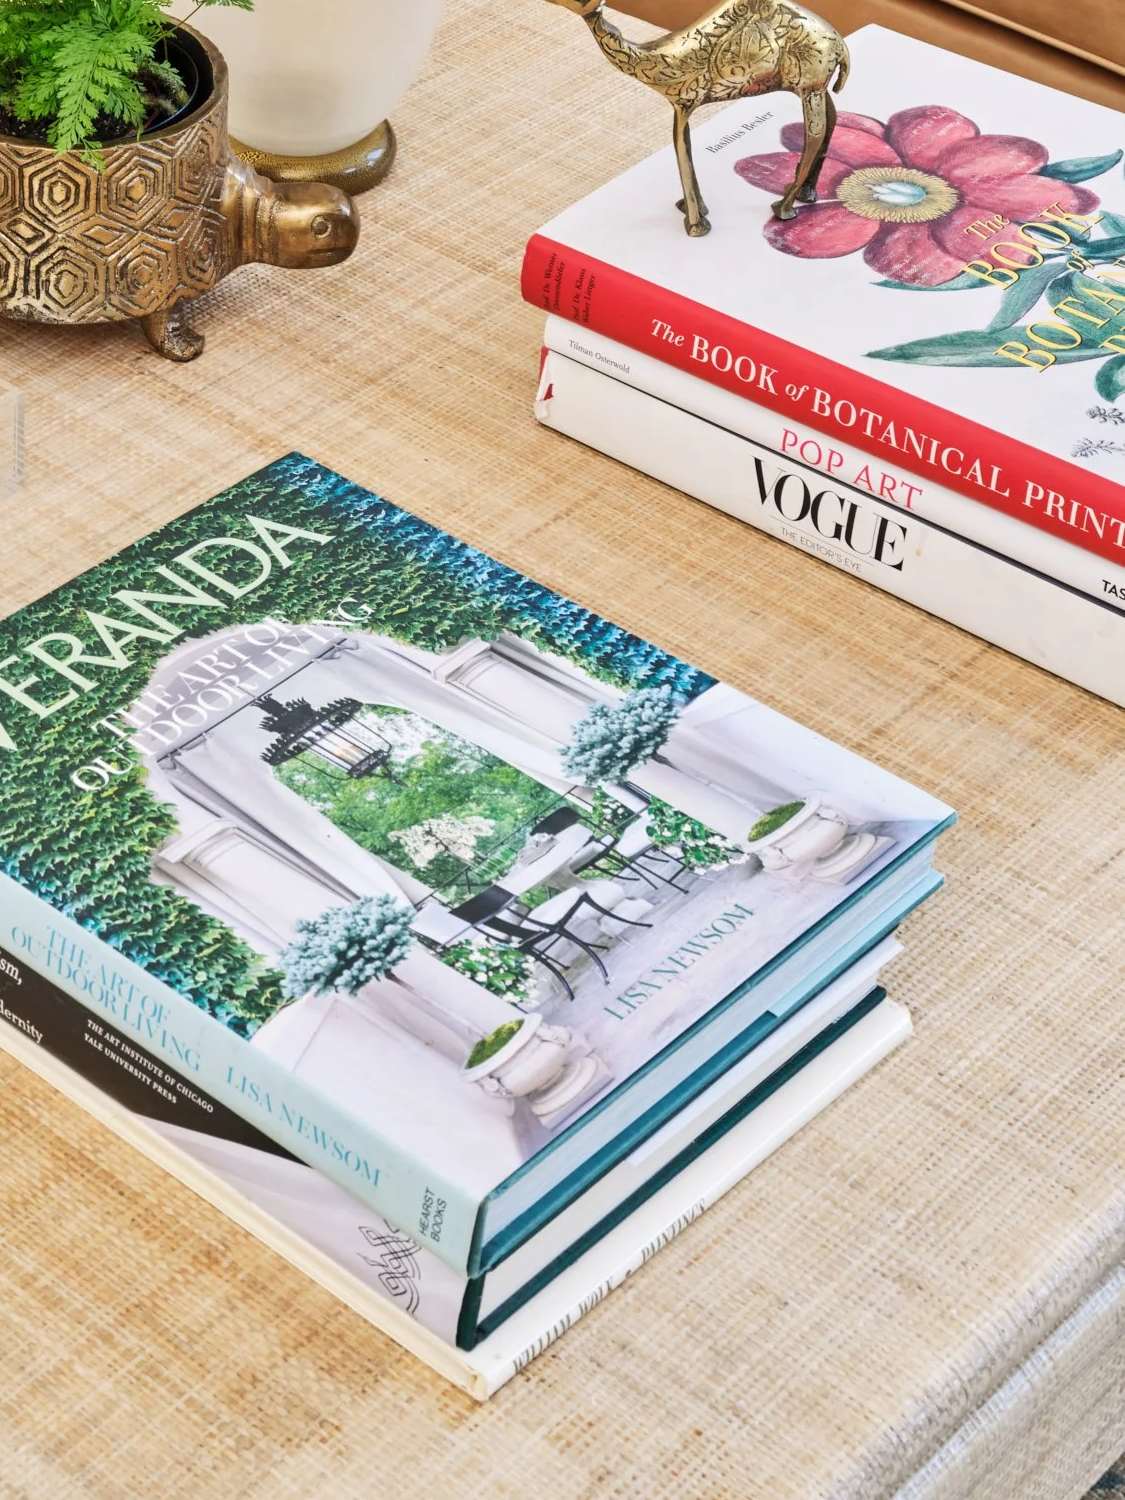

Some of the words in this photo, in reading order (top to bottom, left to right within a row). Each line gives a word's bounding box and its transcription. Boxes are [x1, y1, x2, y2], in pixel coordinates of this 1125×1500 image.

[741, 110, 775, 132] Besler
[544, 252, 557, 279] Werner
[959, 201, 1107, 292] BOOK
[963, 211, 1012, 242] The
[1066, 249, 1095, 272] of
[575, 268, 586, 290] Klaus
[568, 339, 594, 358] Tilman
[594, 351, 631, 375] Osterwold
[649, 318, 686, 348] The
[689, 333, 779, 396] BOOK
[784, 382, 810, 403] of
[810, 387, 1011, 498] BOTANICAL
[779, 427, 845, 476] POP
[853, 463, 924, 512] ART
[751, 454, 908, 572] VOGUE
[780, 526, 798, 543] THE
[843, 553, 863, 574] EYE
[71, 673, 261, 791] OUTDOOR
[259, 596, 375, 681] LIVING
[92, 682, 186, 740] THE
[177, 640, 253, 694] ART
[243, 609, 293, 649] OF
[11, 926, 118, 1016] OUTDOOR
[123, 1002, 202, 1073] LIVING
[46, 926, 92, 974] THE
[94, 963, 141, 1005] ART
[141, 994, 172, 1026] OF
[603, 978, 663, 1021] LISA
[651, 902, 756, 983] NEWSOM
[84, 1032, 104, 1052] YALE
[104, 1047, 152, 1086] UNIVERSITY
[152, 1082, 177, 1104] PRESS
[87, 1019, 104, 1036] THE
[104, 1032, 121, 1047] ART
[120, 1042, 164, 1079] INSTITUTE
[164, 1073, 176, 1087] OF
[176, 1083, 214, 1114] CHICAGO
[226, 1066, 274, 1114] LISA
[279, 1102, 382, 1188] NEWSOM
[419, 1186, 436, 1237] HEARST
[430, 1197, 448, 1243] BOOKS
